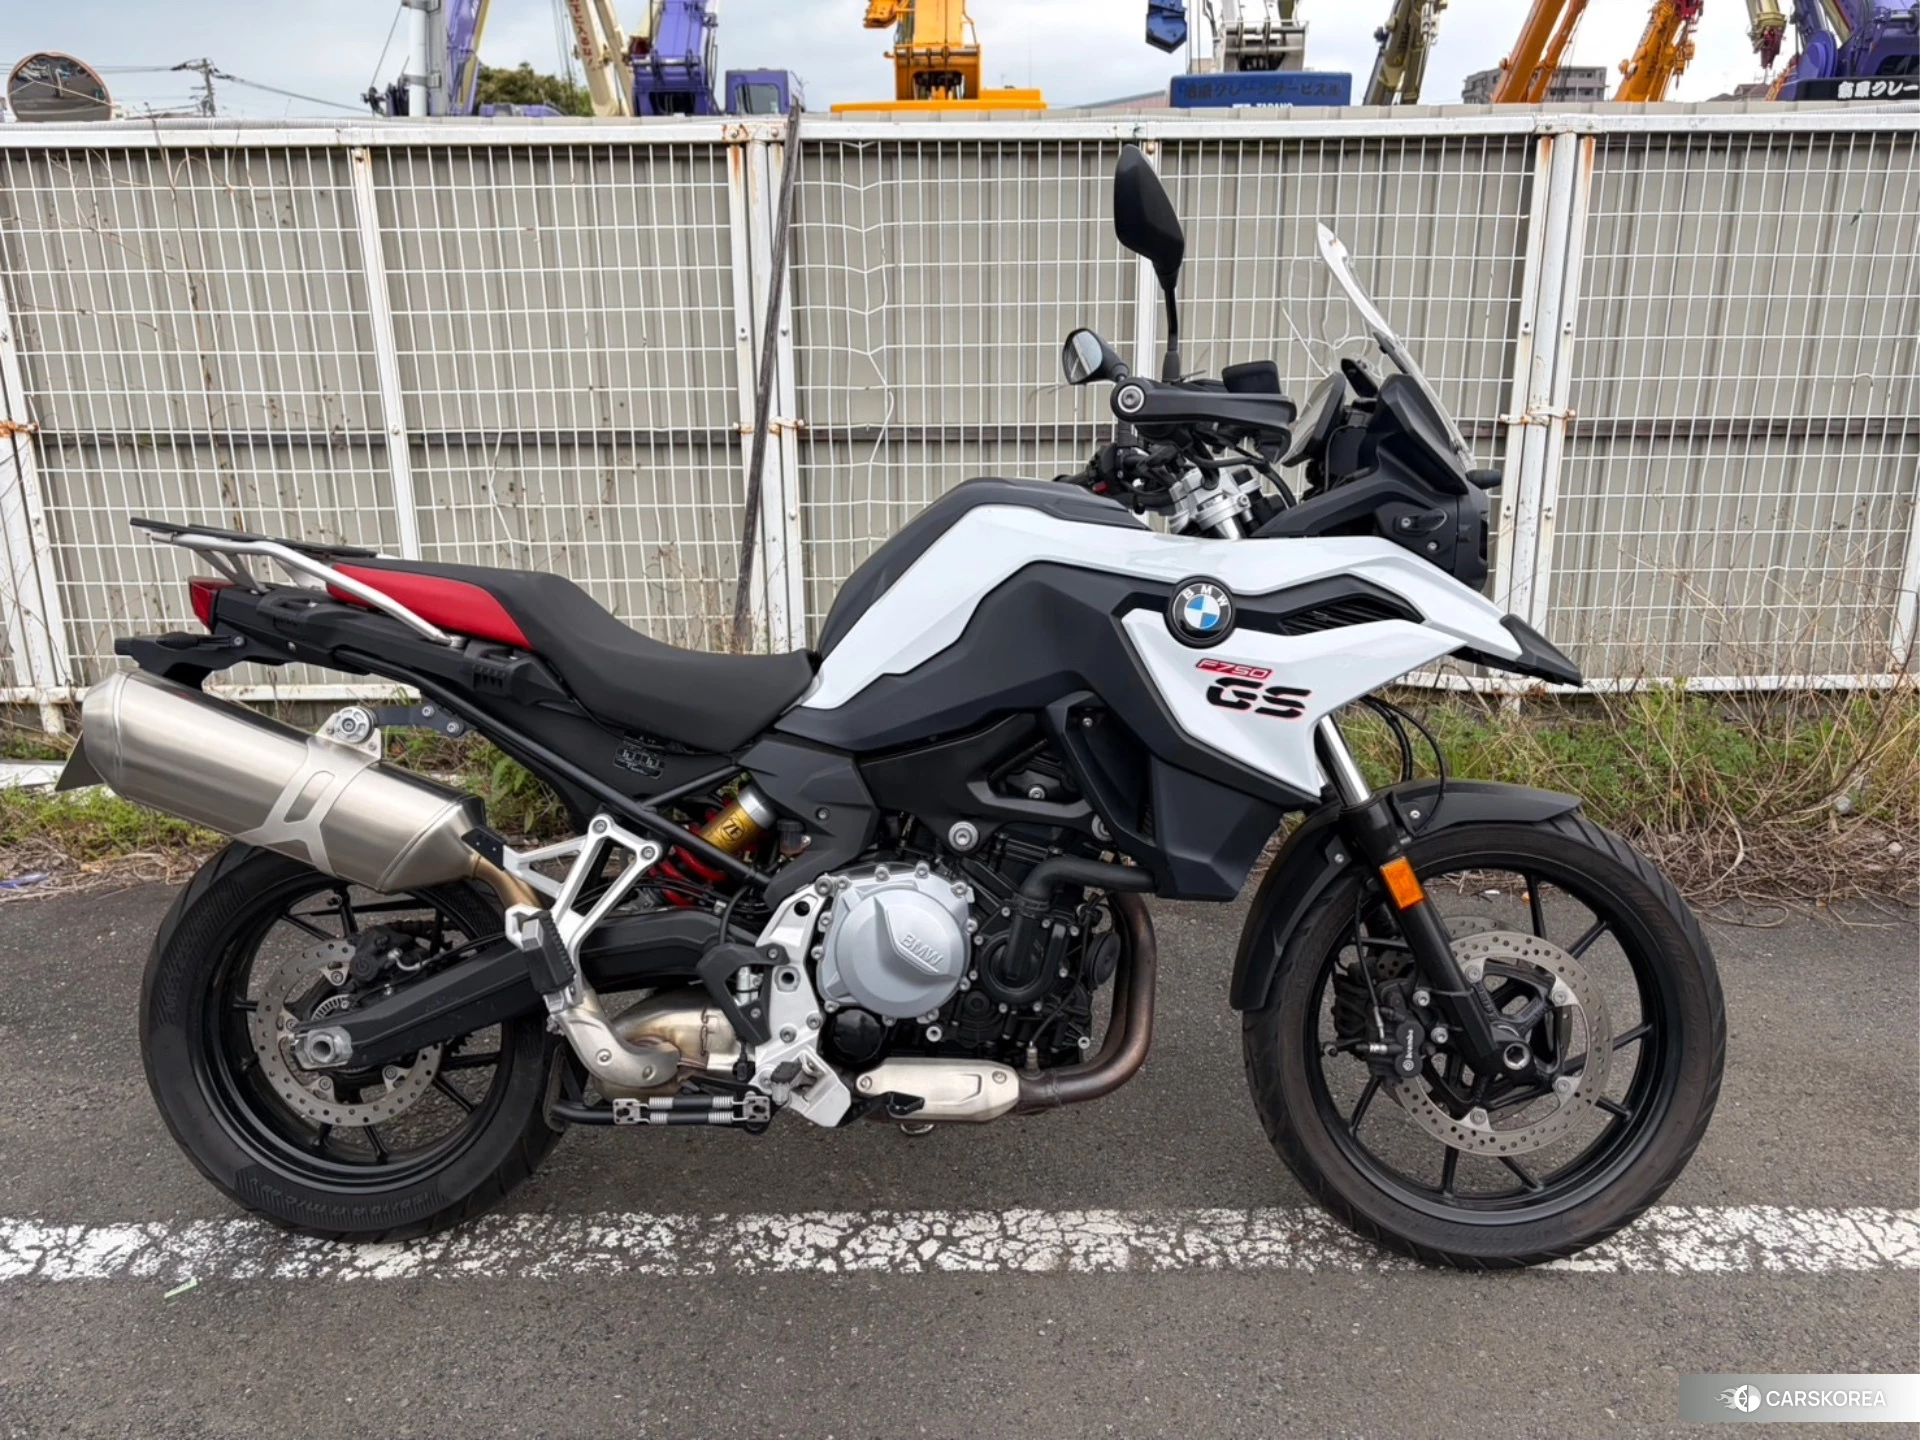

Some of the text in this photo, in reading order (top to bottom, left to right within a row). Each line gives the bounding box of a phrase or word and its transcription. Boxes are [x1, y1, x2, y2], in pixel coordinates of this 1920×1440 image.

[1182, 585, 1228, 607] BMW
[1198, 659, 1270, 679] F750
[1206, 677, 1312, 718] GS
[722, 818, 744, 840] ZF
[901, 932, 944, 968] BMW
